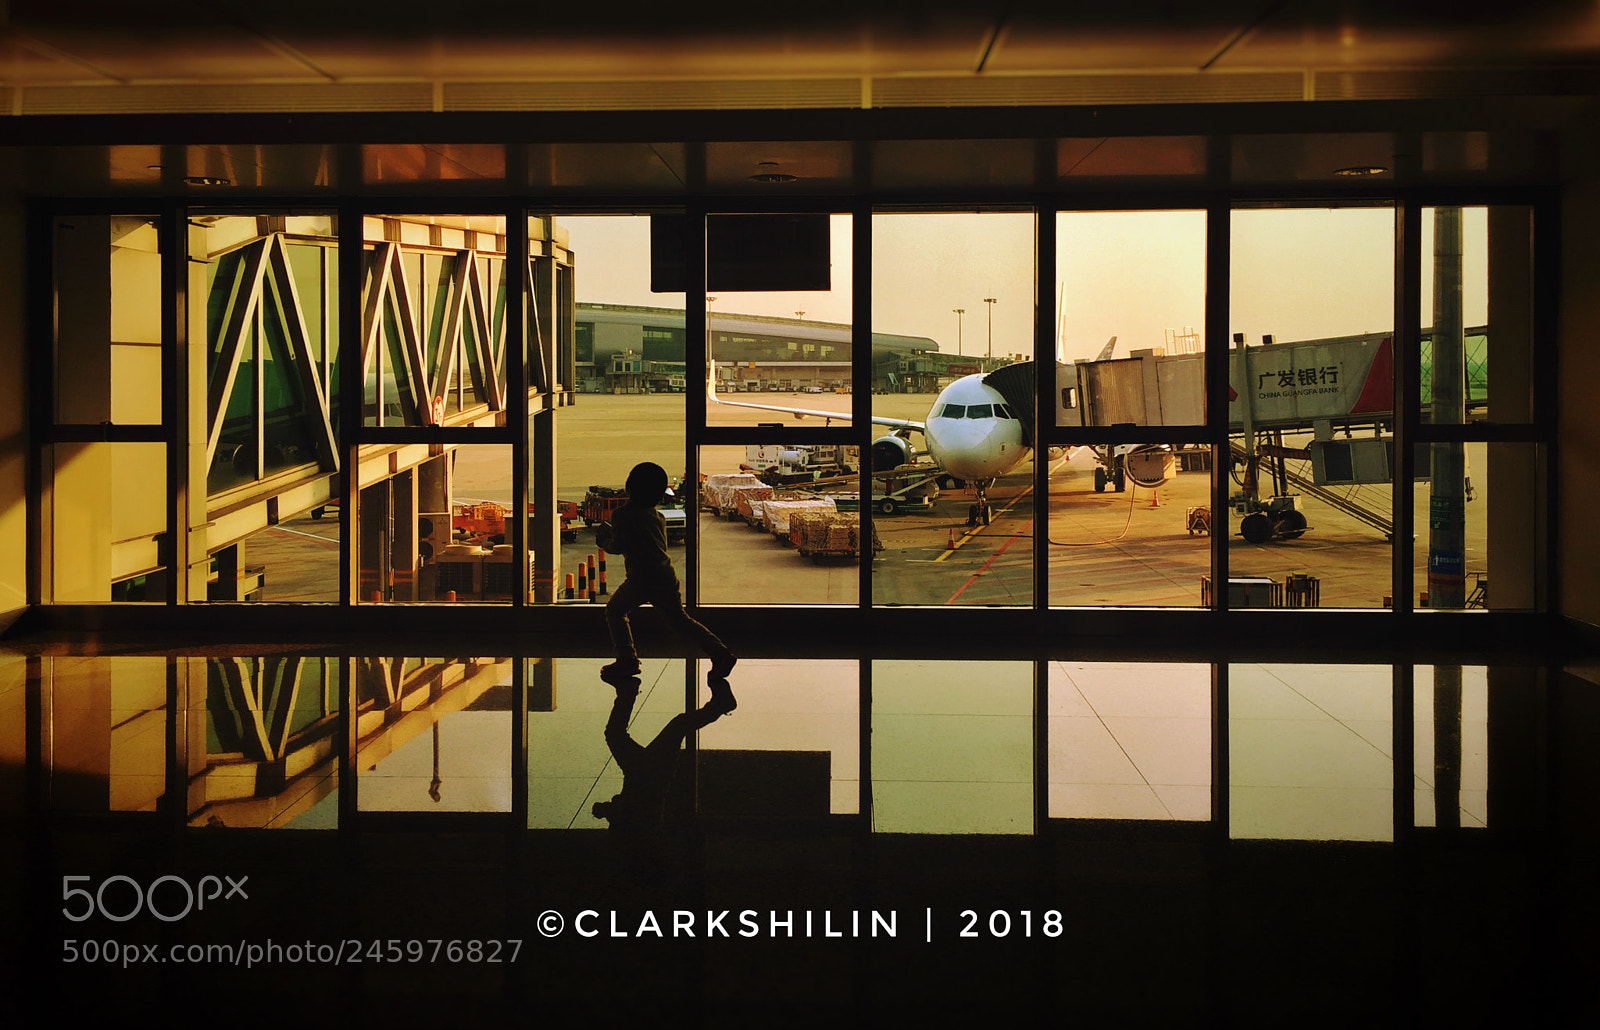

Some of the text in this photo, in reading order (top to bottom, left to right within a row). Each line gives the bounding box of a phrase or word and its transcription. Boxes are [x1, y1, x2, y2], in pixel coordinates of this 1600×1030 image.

[1258, 366, 1339, 390] 广发银行
[1258, 386, 1339, 399] CHINA GUANGFA BANK
